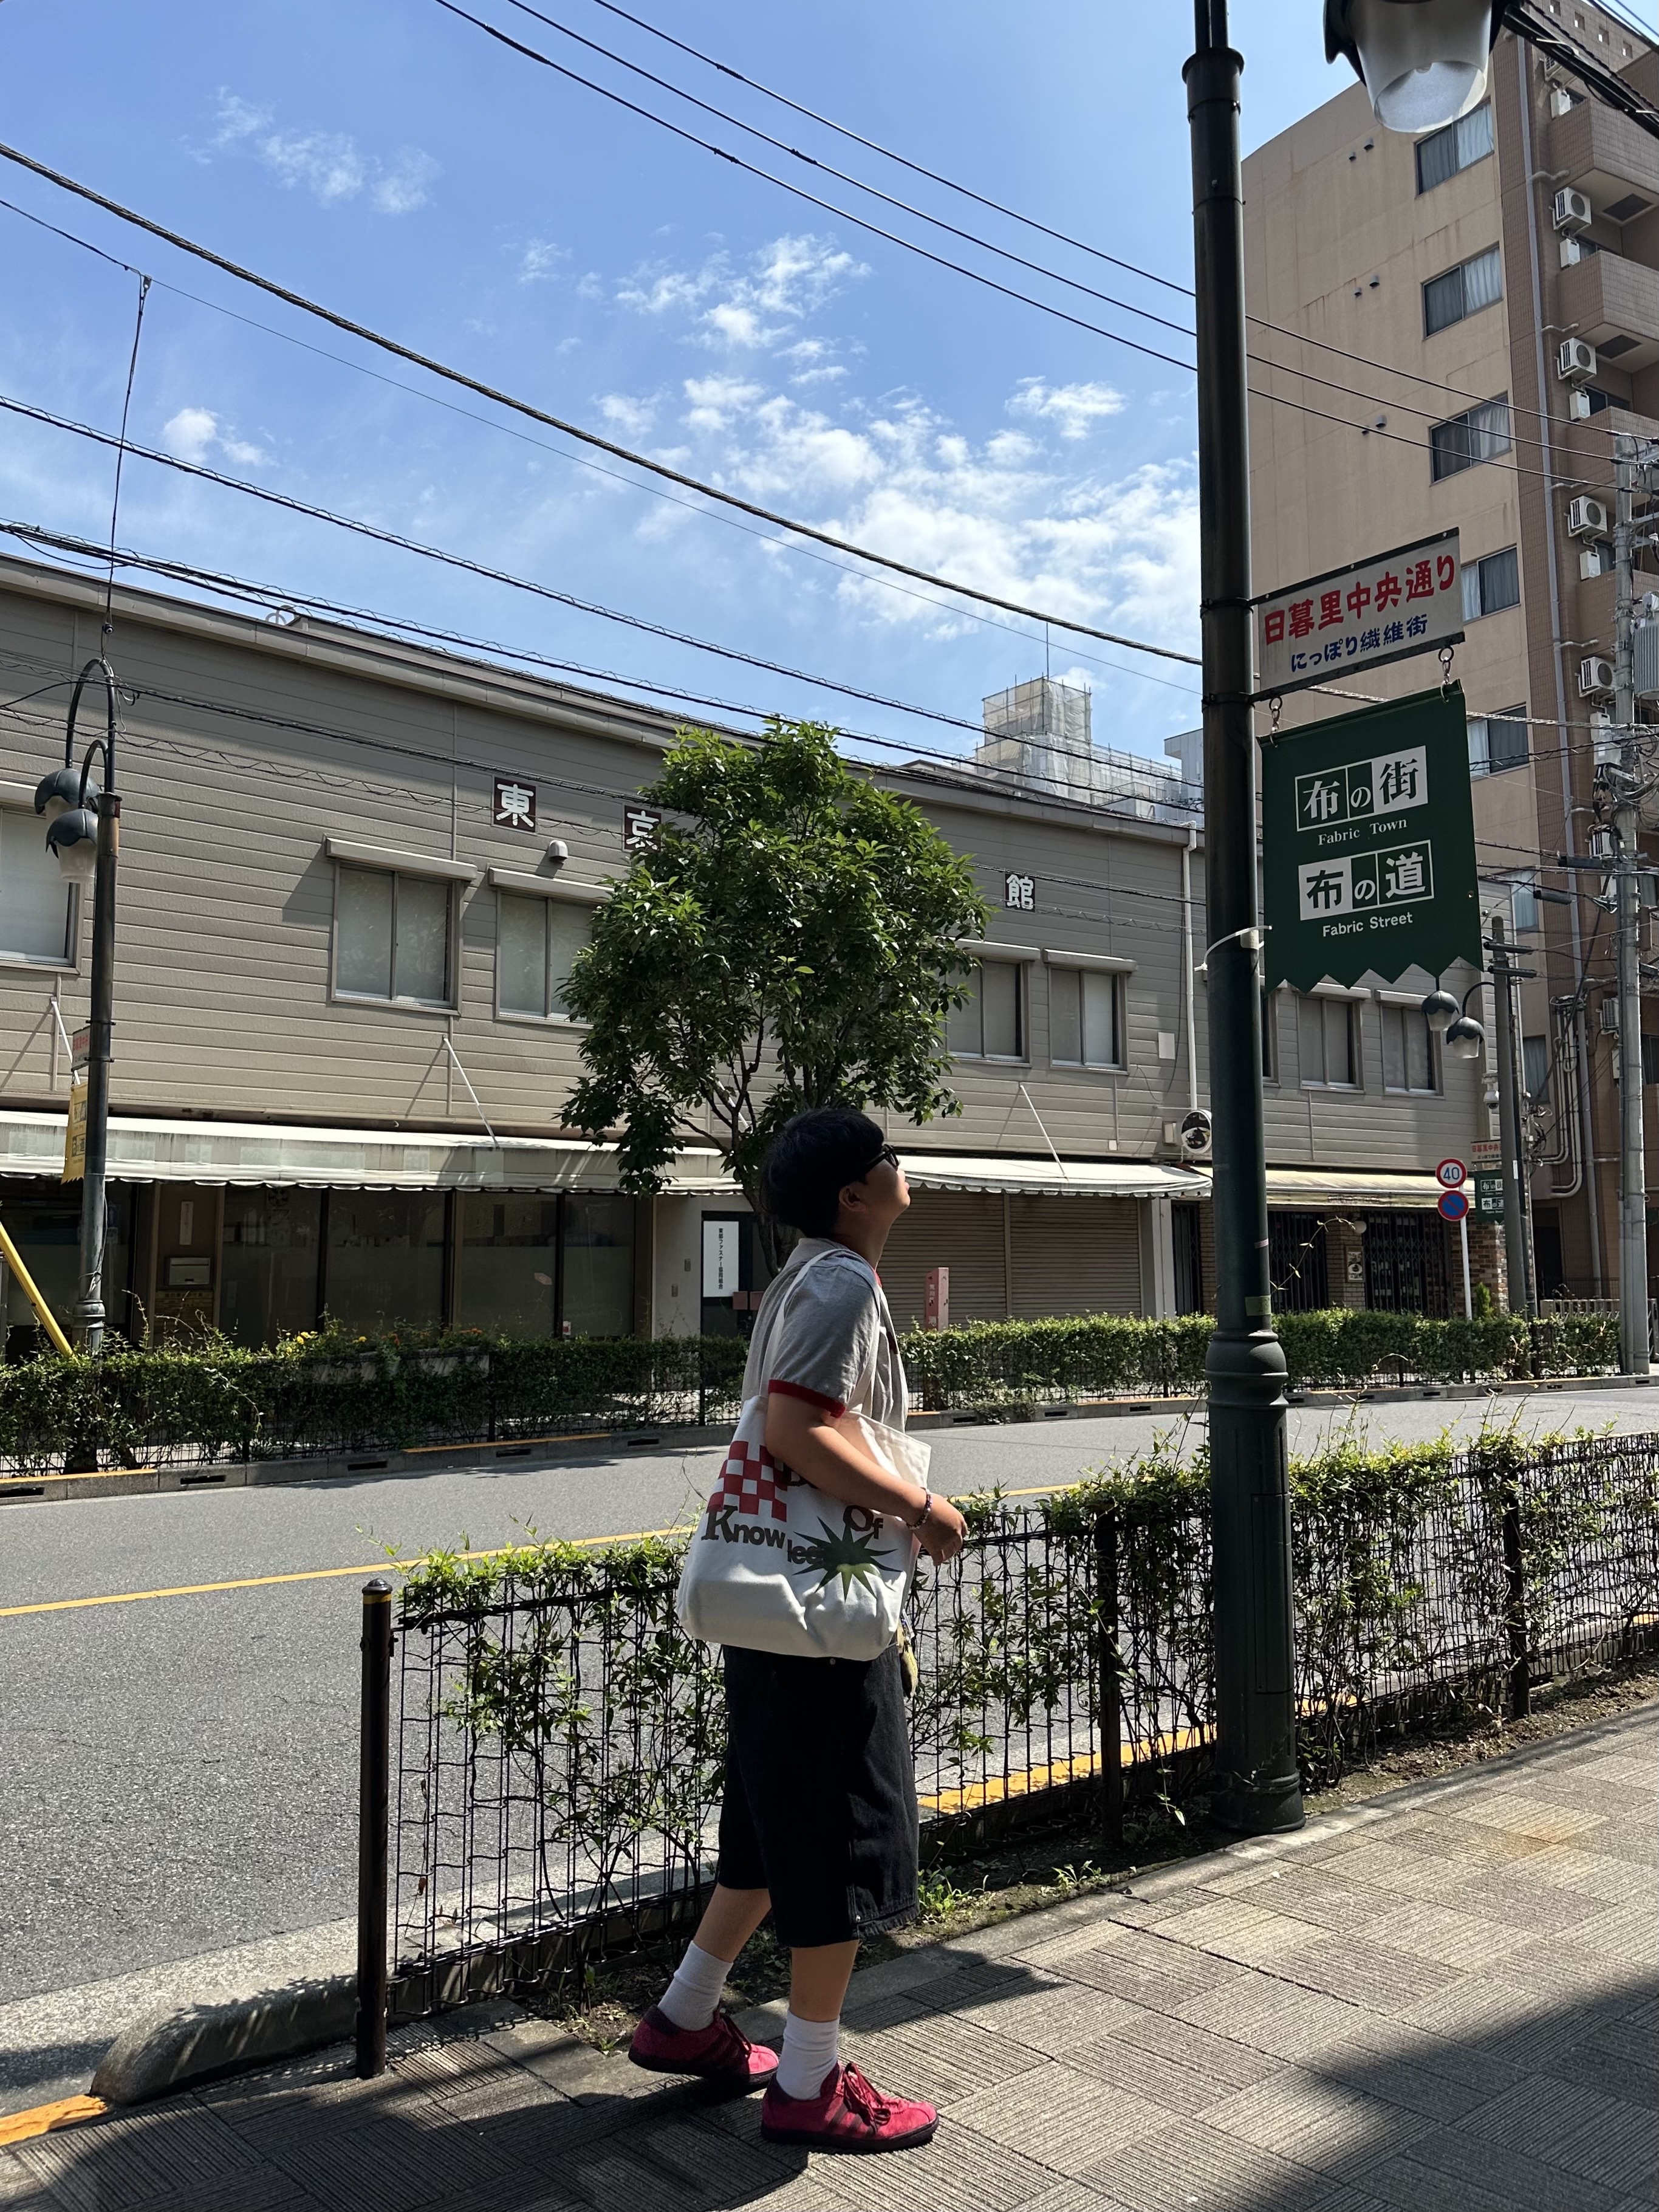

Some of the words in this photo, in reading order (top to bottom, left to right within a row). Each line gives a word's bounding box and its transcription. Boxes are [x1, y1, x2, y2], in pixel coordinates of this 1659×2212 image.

[1264, 555, 1455, 646] 日暮里中央通り
[1290, 613, 1428, 673] にっぽり繊維街
[1302, 756, 1419, 821] 布の街
[496, 784, 535, 827] 東
[1006, 874, 1034, 910] 館
[1318, 827, 1360, 846] Fabric
[1369, 817, 1408, 835] Town
[1306, 852, 1426, 910] 布の道
[1322, 919, 1363, 937] Fabric
[1369, 911, 1414, 930] Street
[1472, 1143, 1502, 1152] 日暮里中央
[1443, 1166, 1460, 1180] 40
[843, 1504, 884, 1539] Of
